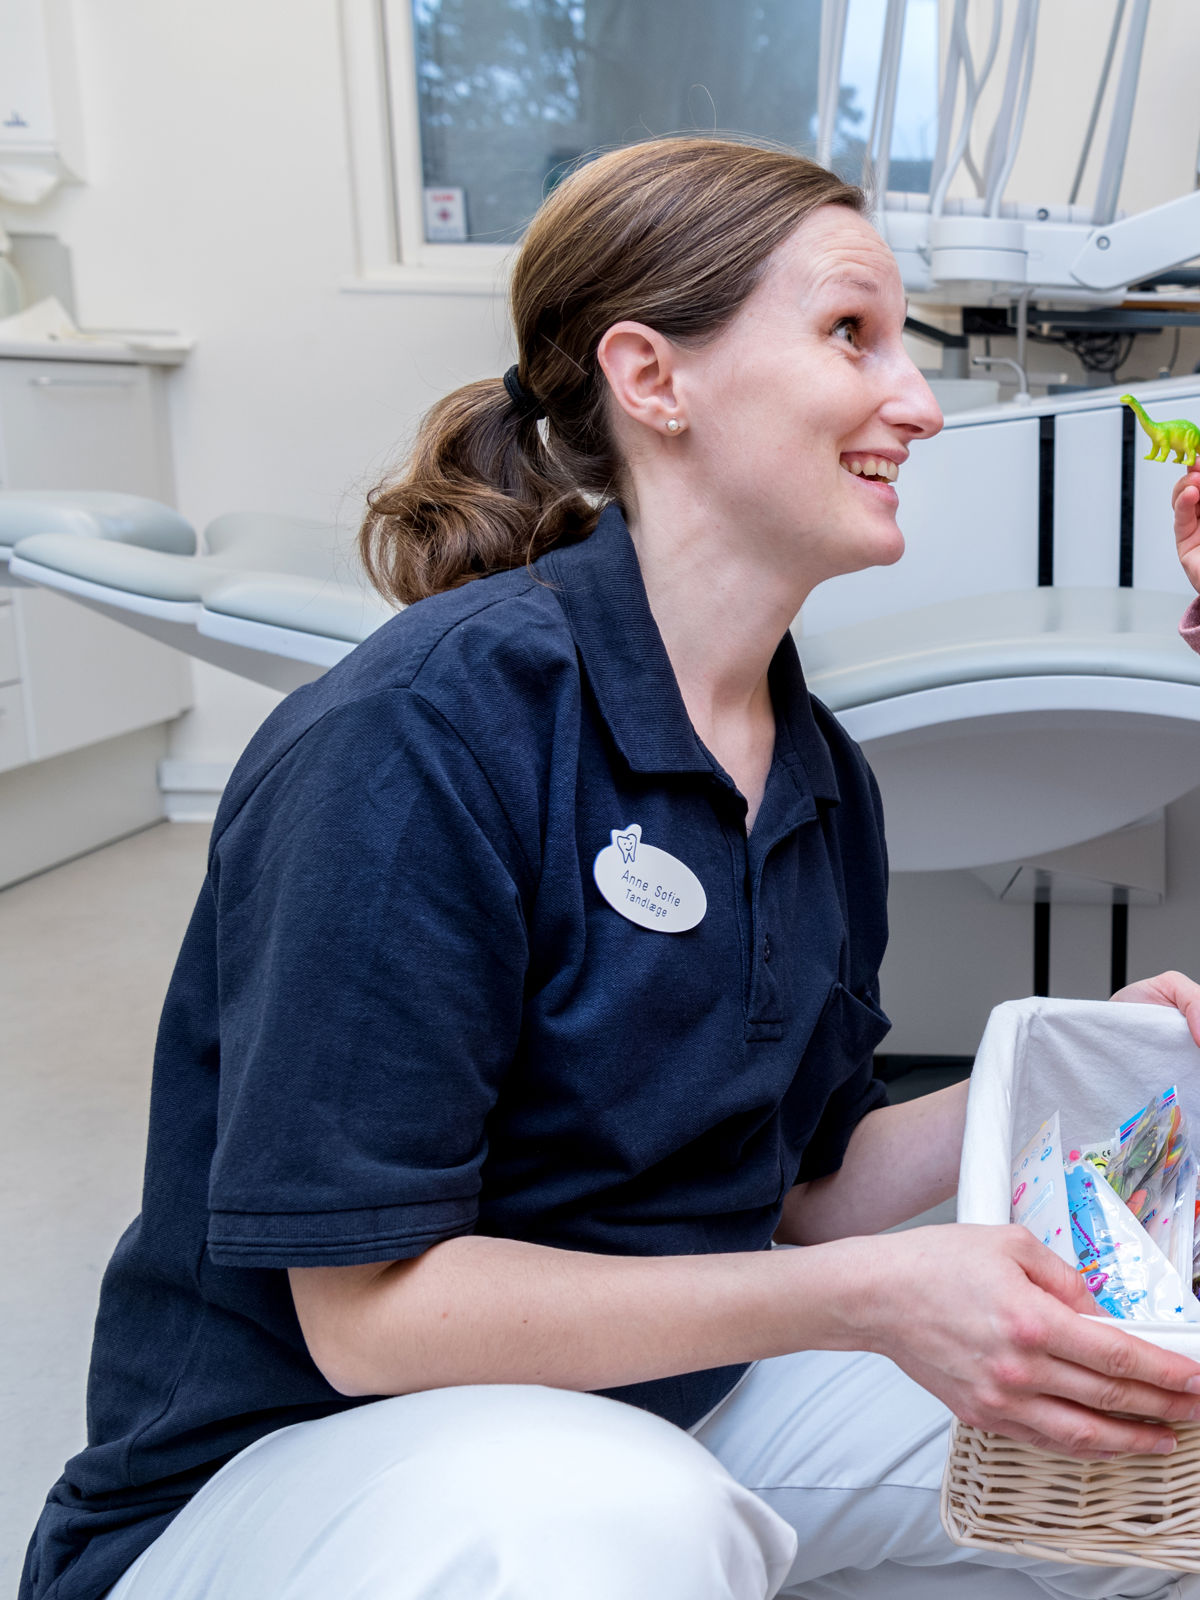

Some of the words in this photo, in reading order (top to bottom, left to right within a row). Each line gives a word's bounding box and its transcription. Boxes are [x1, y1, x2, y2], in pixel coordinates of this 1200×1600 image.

[621, 870, 648, 891] Anne
[655, 886, 680, 906] Sofie
[626, 889, 667, 917] Tandlæge
